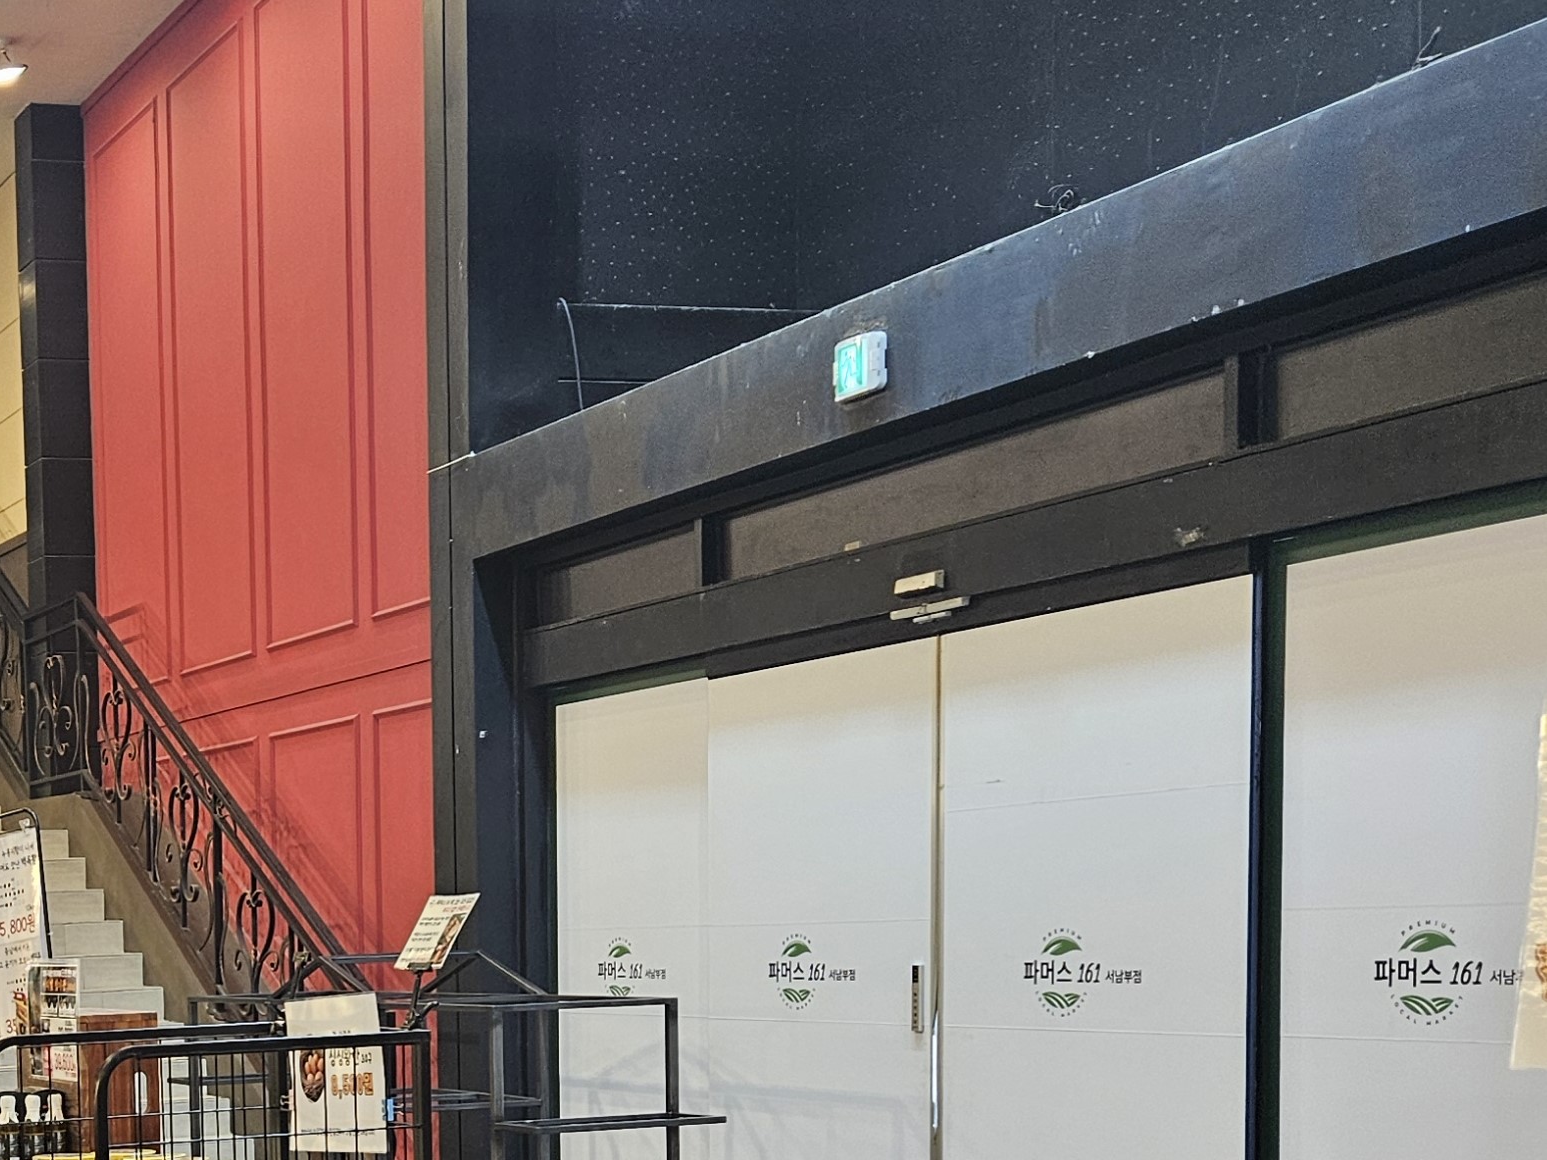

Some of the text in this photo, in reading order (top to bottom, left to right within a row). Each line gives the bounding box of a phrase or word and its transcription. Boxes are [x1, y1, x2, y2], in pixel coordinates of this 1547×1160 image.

[1401, 919, 1457, 936] PREMIUM
[598, 961, 626, 980] 파머스
[629, 963, 643, 980] 161
[768, 961, 856, 982] 파머스 161 서남부점
[1024, 960, 1143, 985] 파머스 161 서남부점
[1374, 958, 1524, 988] 파머스 161 서남
[1390, 994, 1464, 1026] LOCAL MARKET
